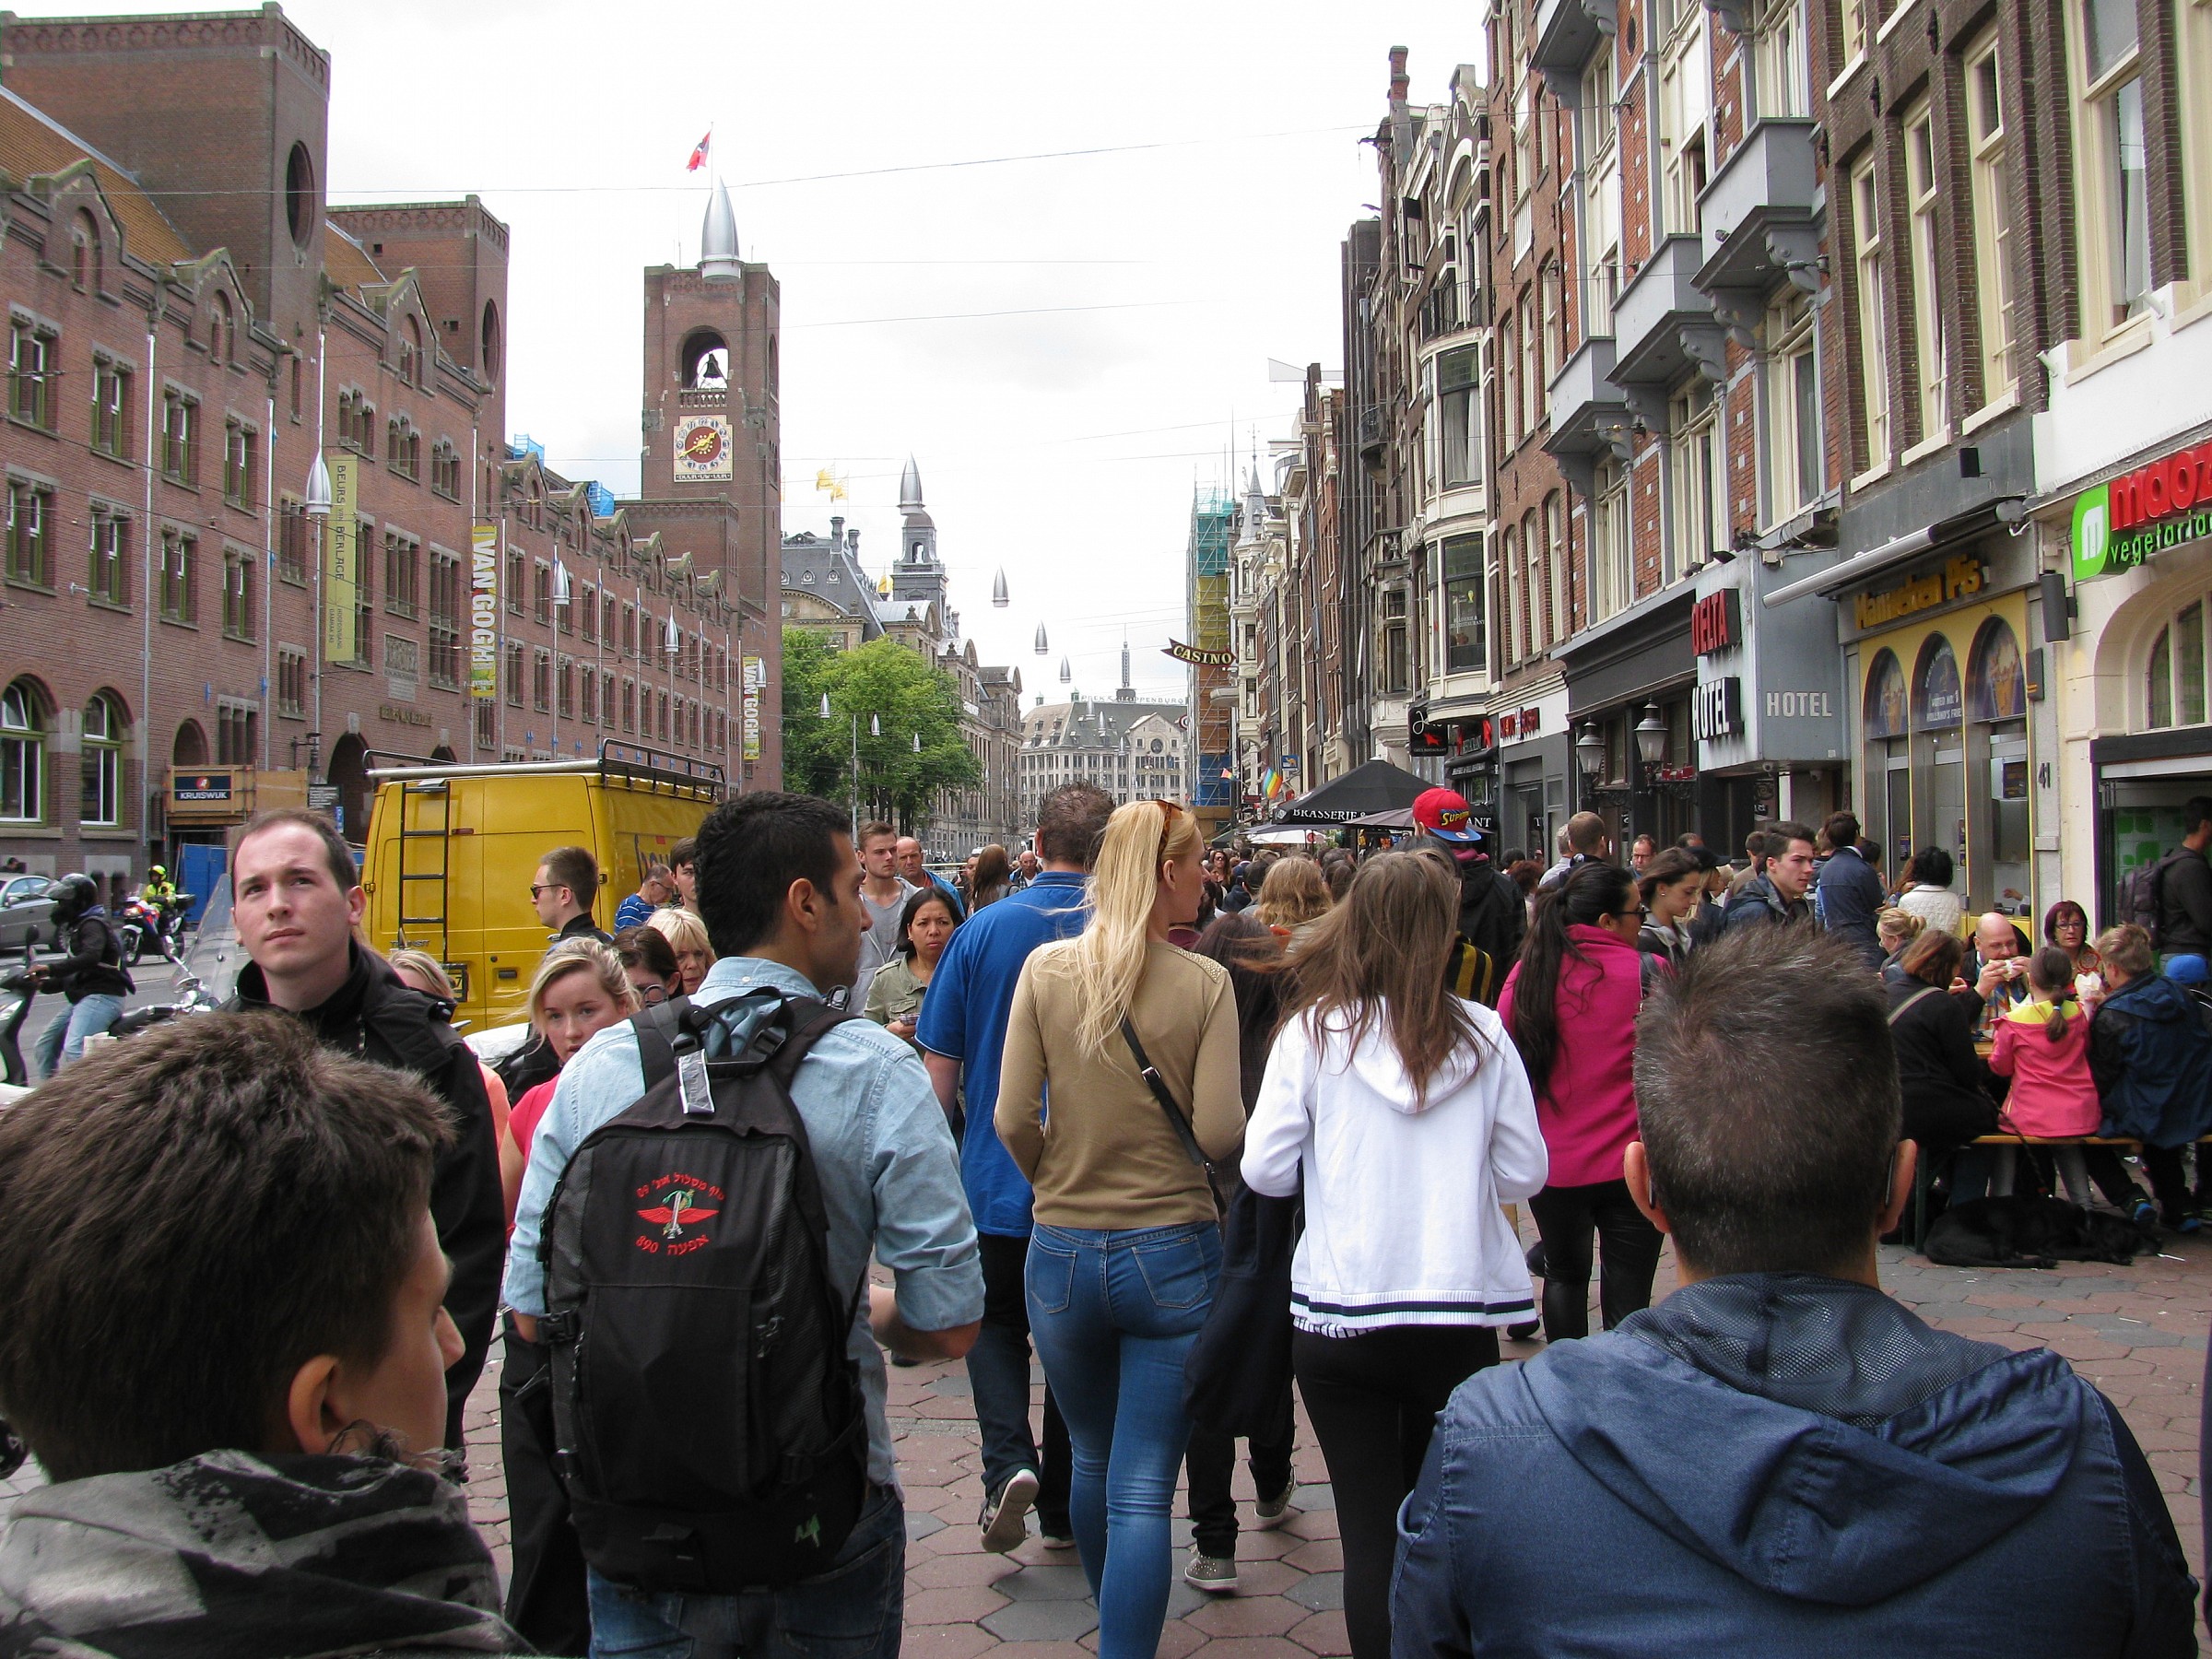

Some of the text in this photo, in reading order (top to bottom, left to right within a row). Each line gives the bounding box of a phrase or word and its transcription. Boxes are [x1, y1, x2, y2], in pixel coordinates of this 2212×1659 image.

[336, 465, 347, 504] BEURS
[2109, 439, 2212, 532] maoz
[335, 525, 346, 582] BERLAGE
[472, 539, 497, 589] VAN
[2111, 510, 2212, 567] vegetaria
[1946, 553, 1981, 599] Pis
[472, 594, 497, 663] GOGH
[1691, 589, 1729, 657] DELTA
[1172, 645, 1232, 665] CASINO
[1691, 677, 1730, 742] HOTEL
[1766, 691, 1832, 717] HOTEL
